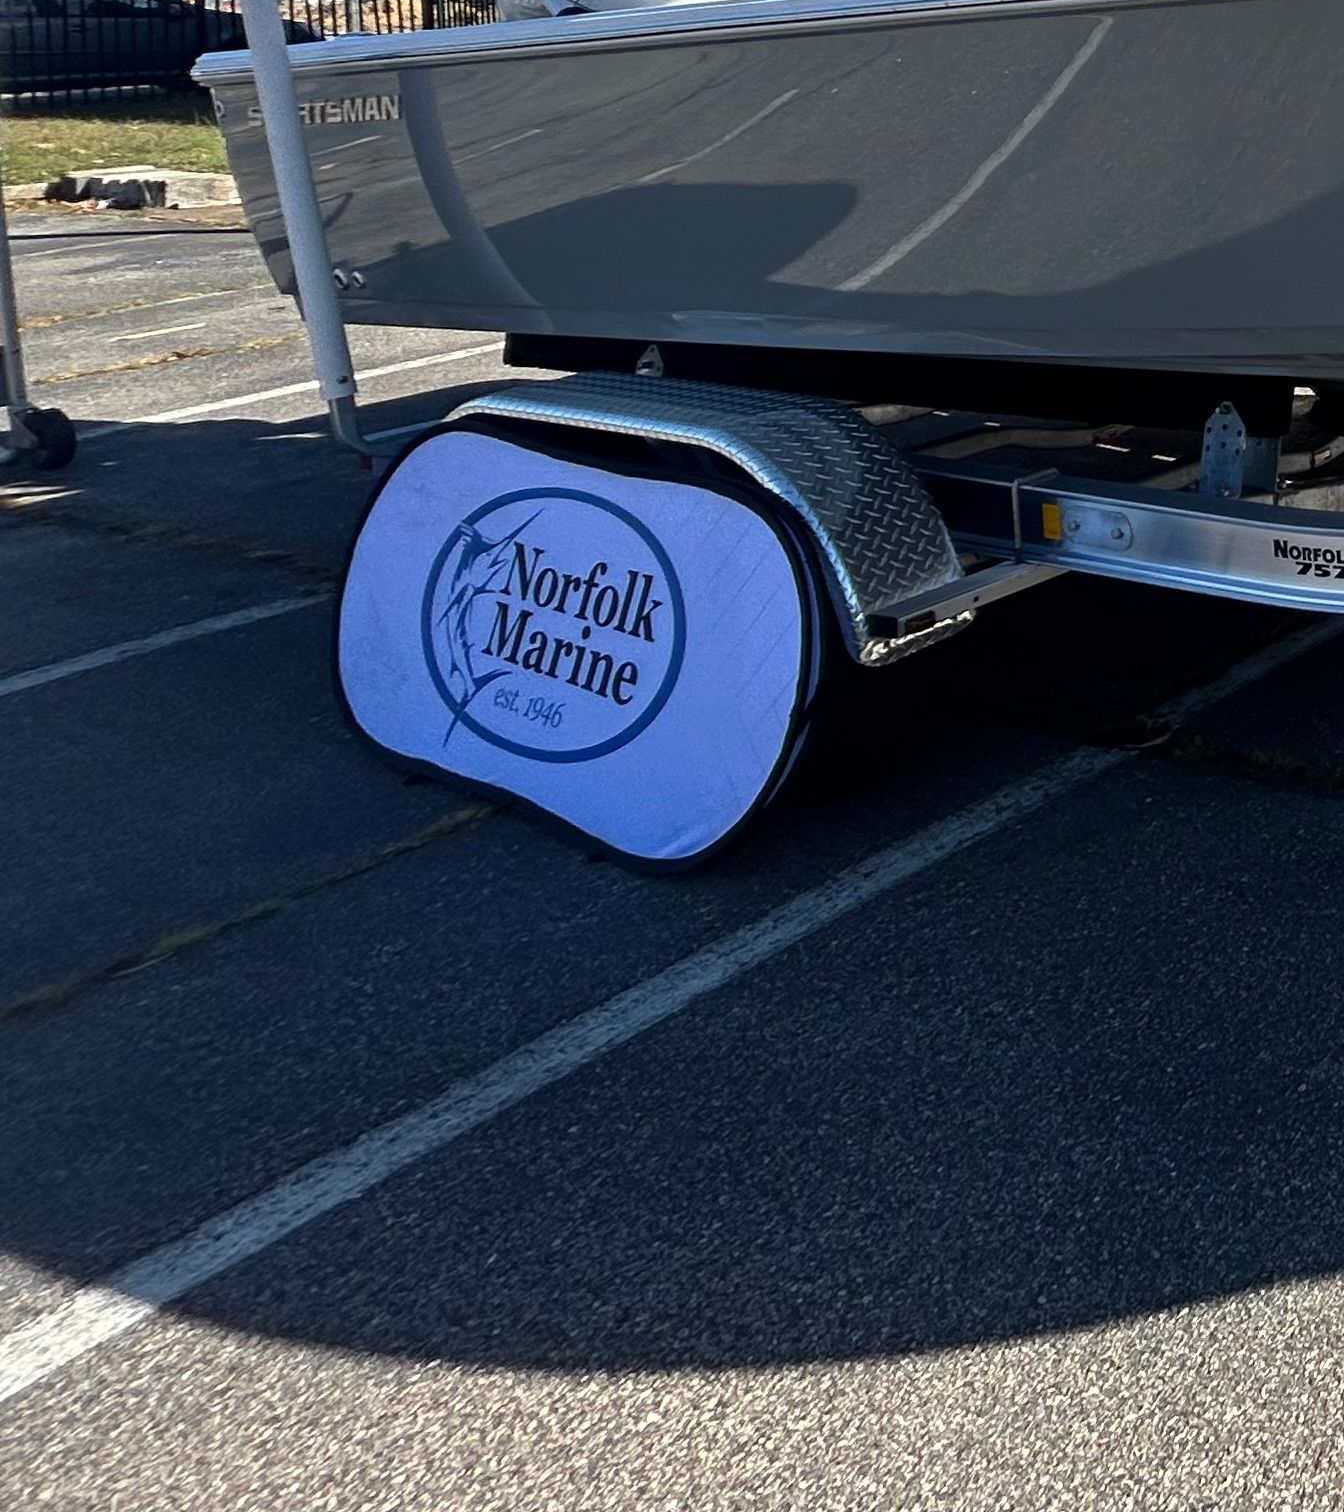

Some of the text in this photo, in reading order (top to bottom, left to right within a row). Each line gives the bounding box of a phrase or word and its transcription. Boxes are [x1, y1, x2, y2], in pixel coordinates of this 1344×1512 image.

[248, 95, 400, 127] SRTSMAN
[499, 541, 664, 643] Norfolk
[481, 601, 639, 706] Marine
[523, 695, 567, 729] 1946
